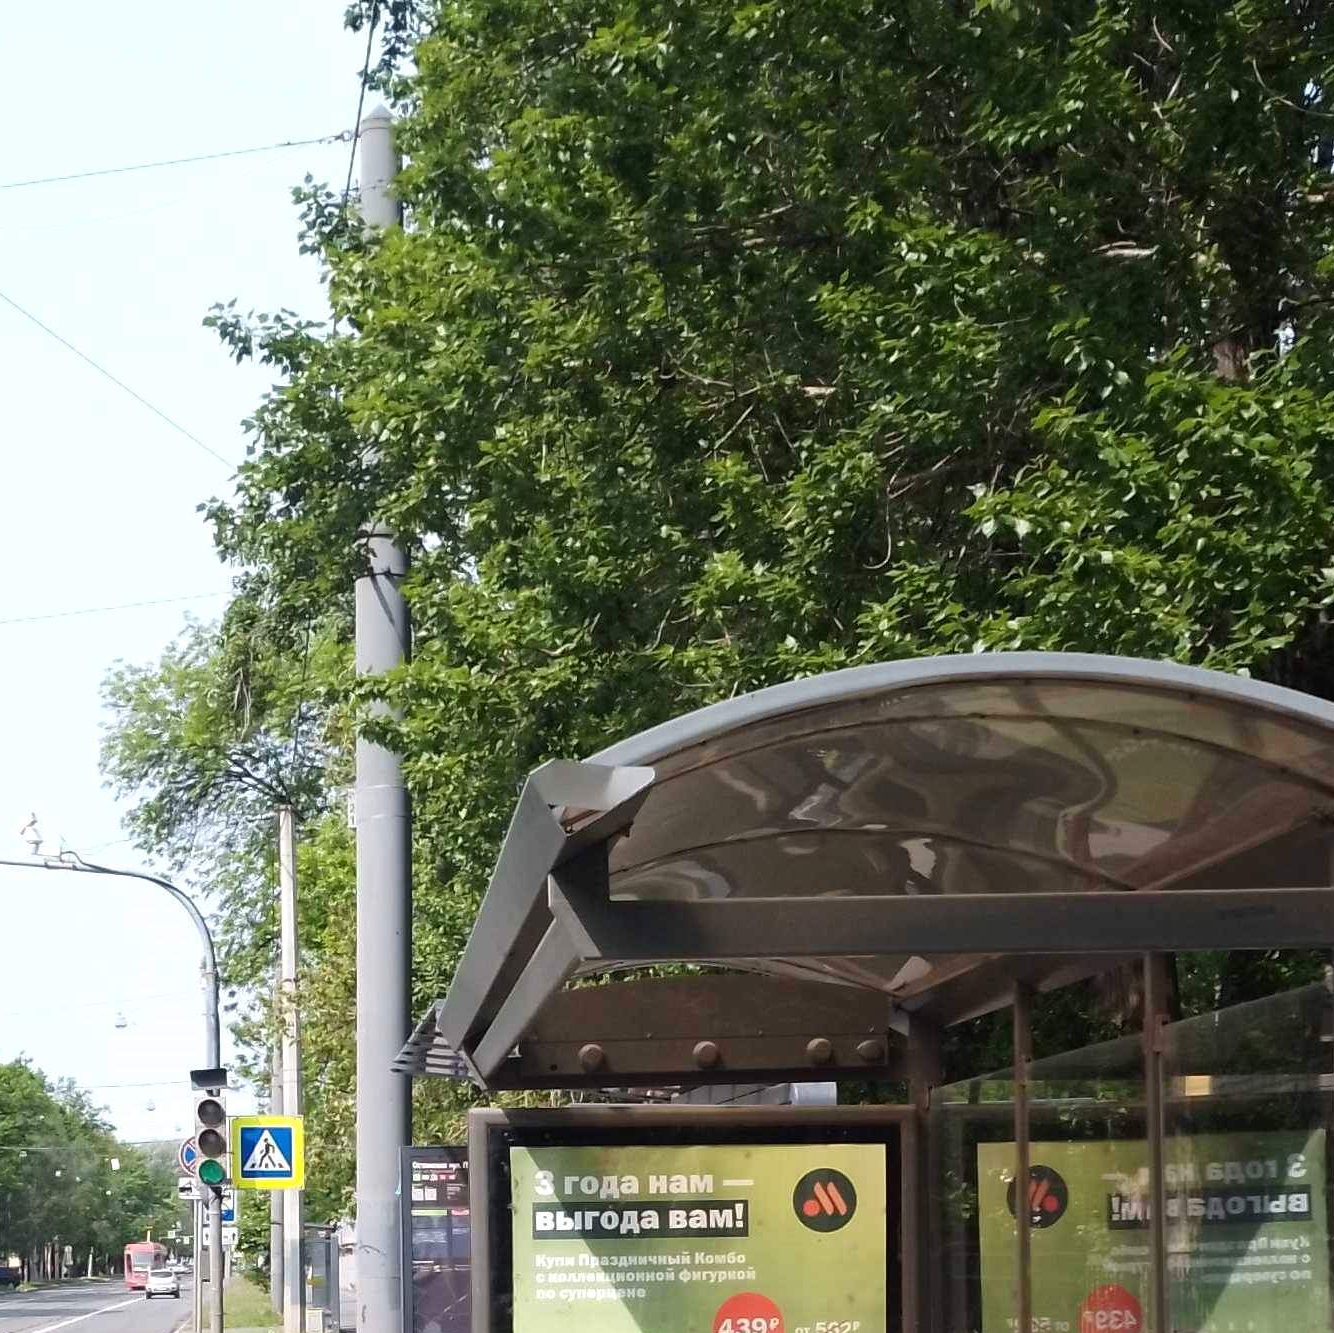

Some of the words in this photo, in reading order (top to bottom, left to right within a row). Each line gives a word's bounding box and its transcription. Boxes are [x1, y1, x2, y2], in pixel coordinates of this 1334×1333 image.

[535, 1171, 554, 1196] 3
[564, 1175, 639, 1199] года
[649, 1172, 714, 1194] нам
[535, 1207, 659, 1234] выгода
[670, 1203, 744, 1230] вам!
[535, 1254, 575, 1269] Купи
[579, 1251, 691, 1268] Праздничный
[695, 1252, 746, 1265] Комбо
[548, 1268, 675, 1284] коллекционной
[679, 1267, 756, 1283] фигуркой
[536, 1288, 555, 1300] по
[560, 1287, 646, 1302] суперцене
